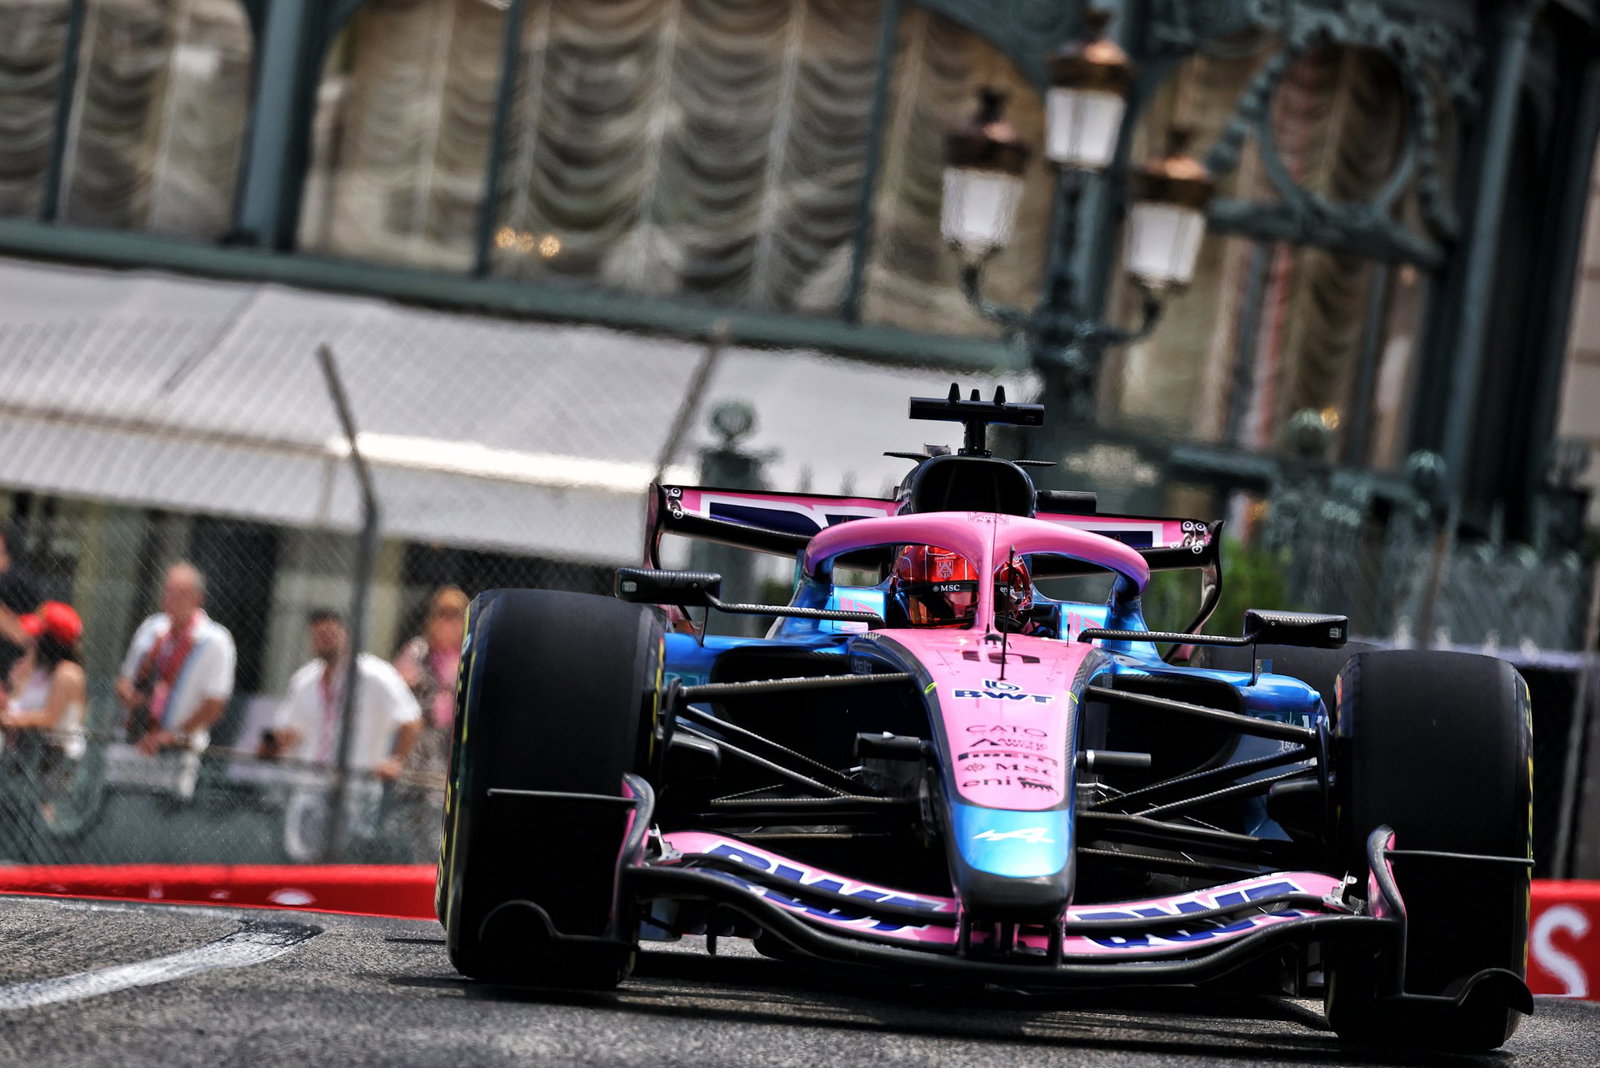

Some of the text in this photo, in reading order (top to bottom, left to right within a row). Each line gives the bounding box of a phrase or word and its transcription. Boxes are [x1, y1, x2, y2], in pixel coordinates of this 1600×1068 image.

[940, 584, 960, 592] MSC
[955, 690, 1053, 703] BWT
[996, 763, 1054, 776] MSC
[962, 776, 1011, 787] eni
